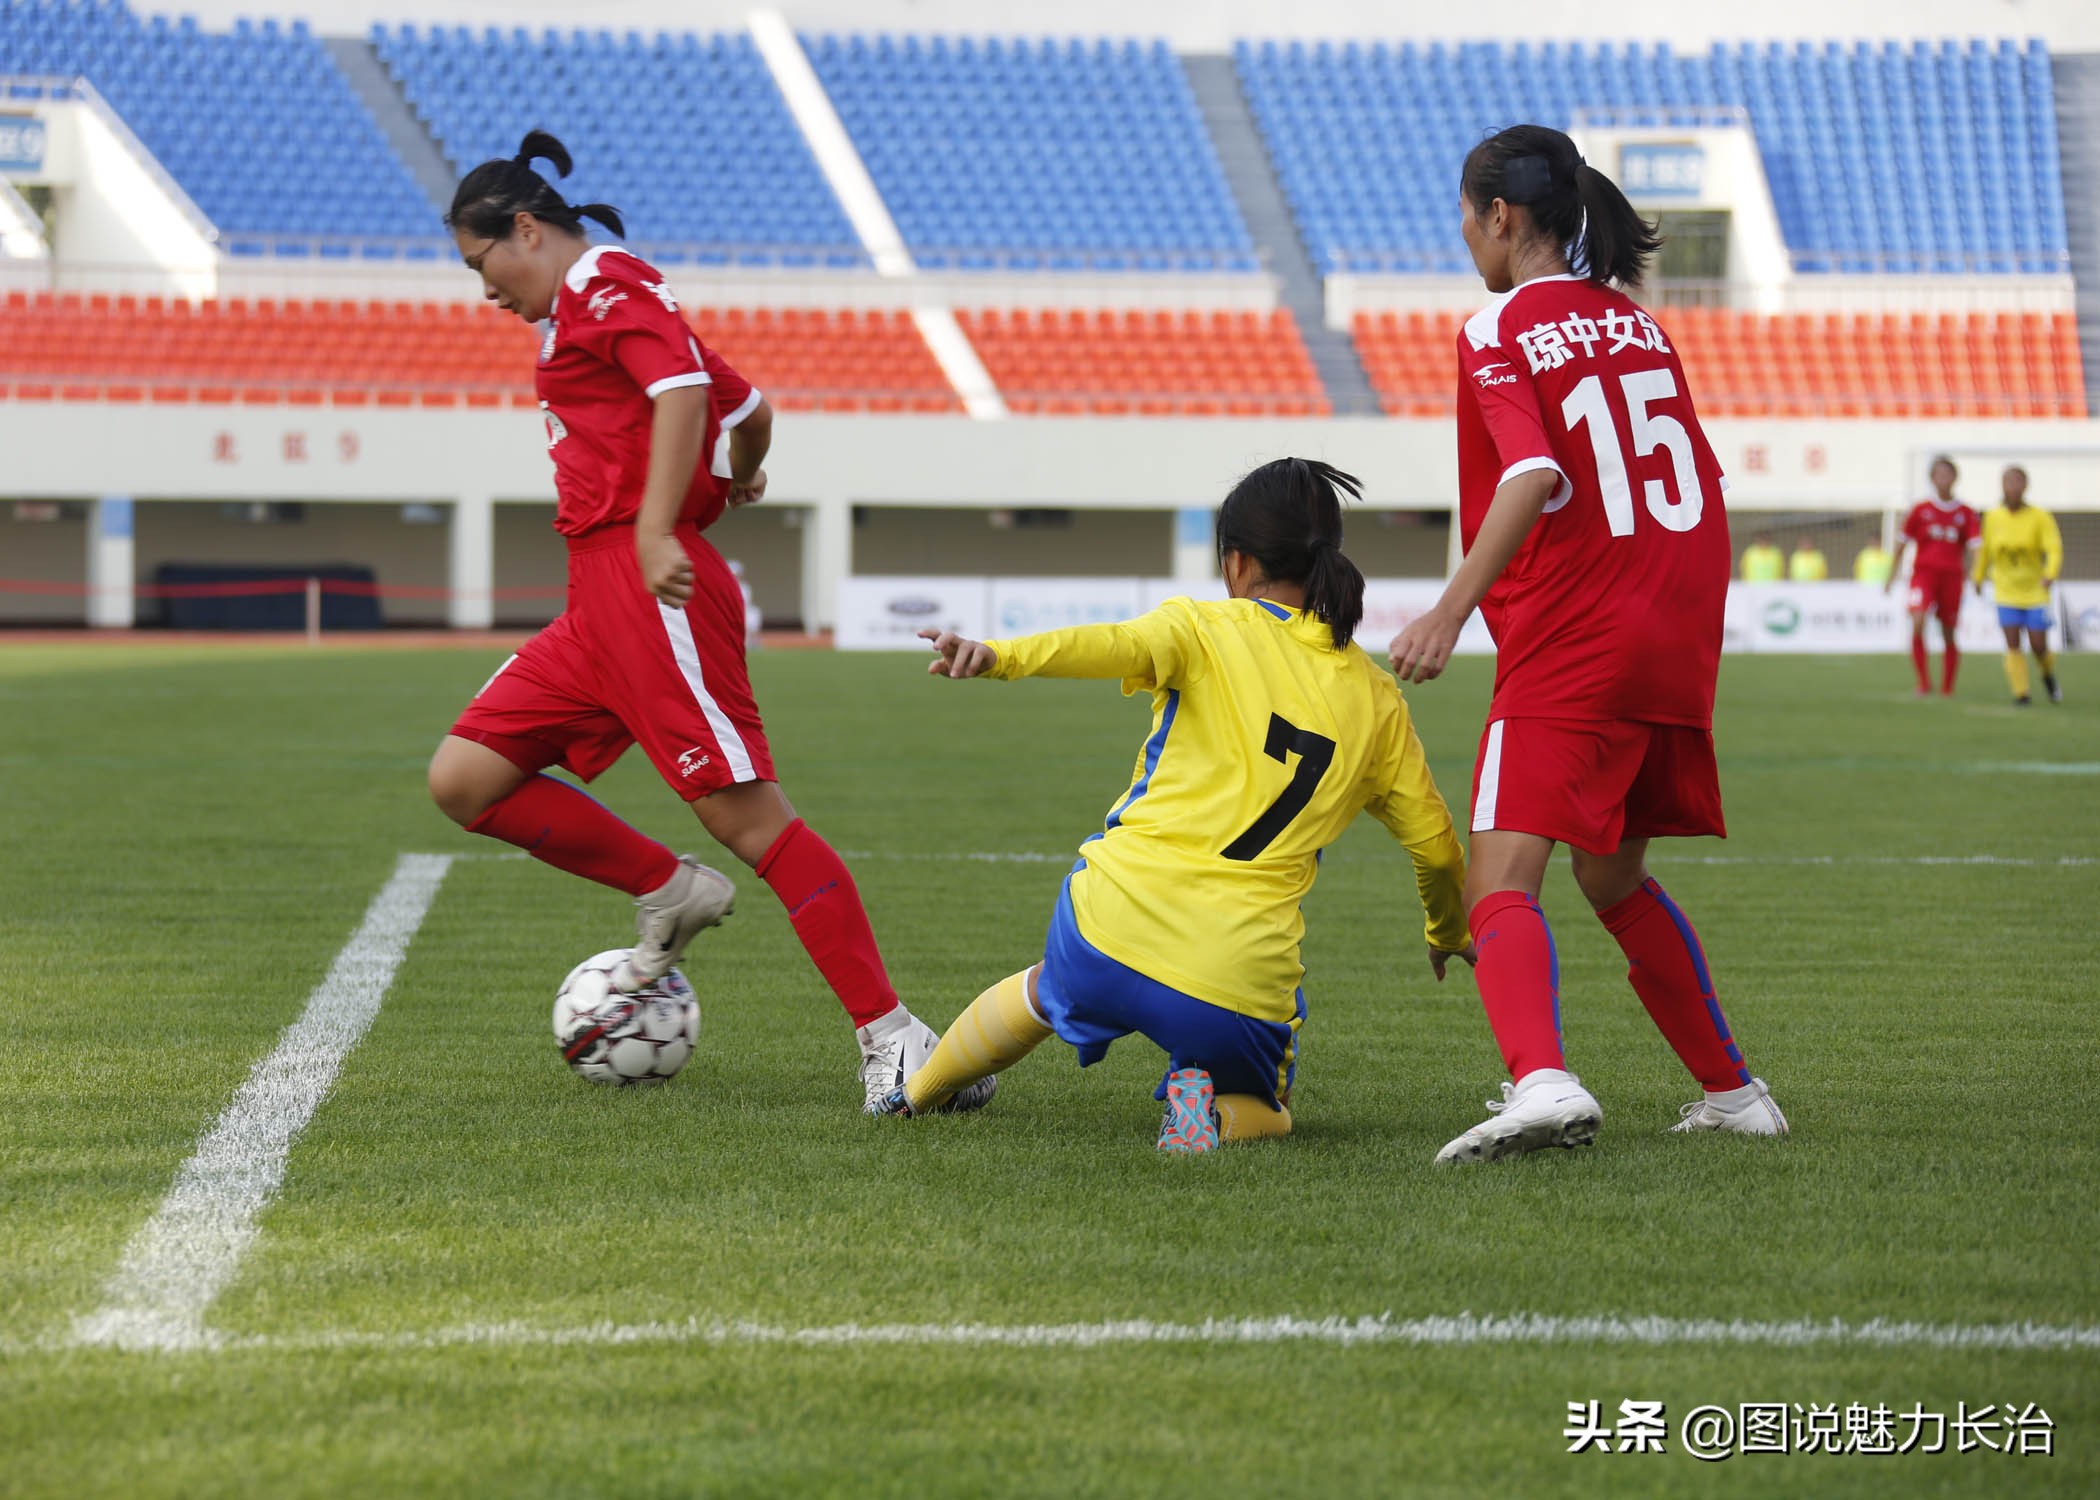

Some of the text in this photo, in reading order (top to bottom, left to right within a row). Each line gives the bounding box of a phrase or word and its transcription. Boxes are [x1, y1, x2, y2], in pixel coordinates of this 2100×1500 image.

[1478, 374, 1518, 389] UNAIS
[1515, 308, 1672, 376] 琼中女足
[1561, 368, 1704, 537] 15
[1219, 711, 1337, 862] 7
